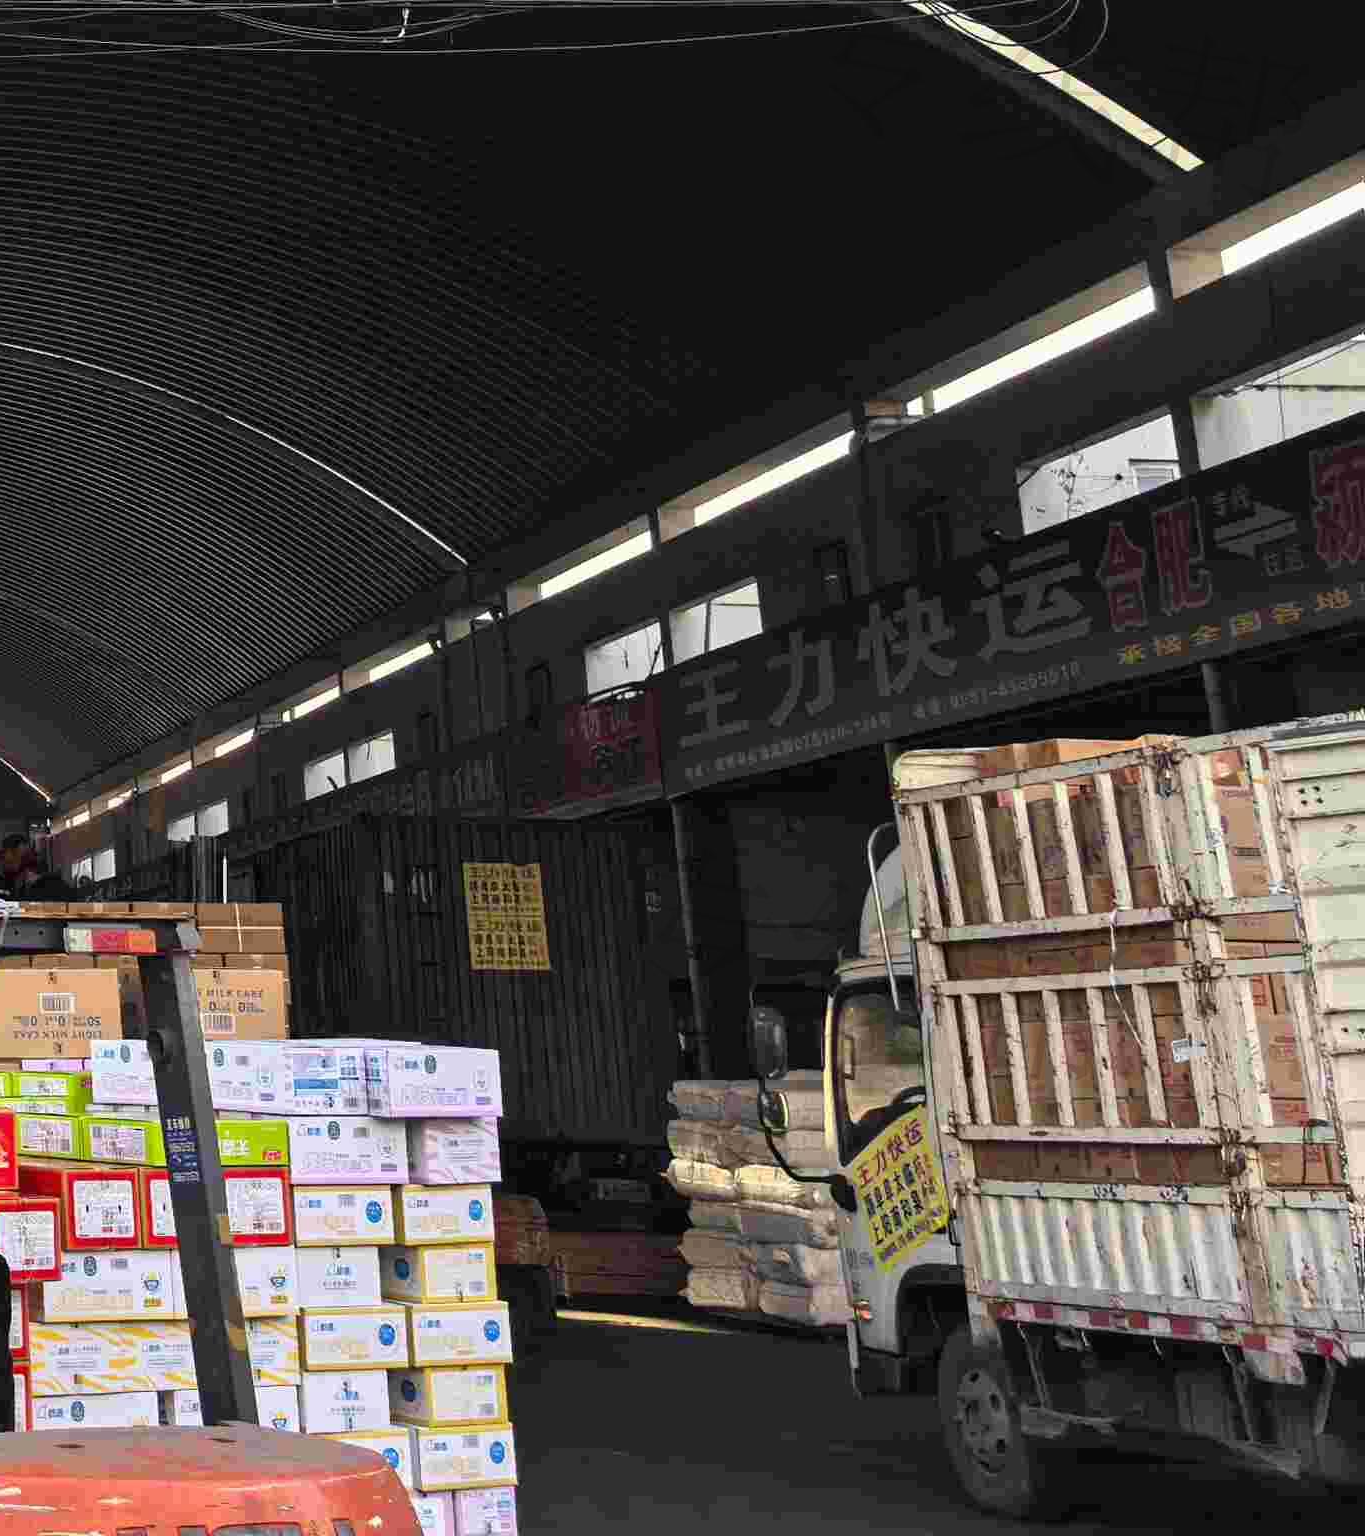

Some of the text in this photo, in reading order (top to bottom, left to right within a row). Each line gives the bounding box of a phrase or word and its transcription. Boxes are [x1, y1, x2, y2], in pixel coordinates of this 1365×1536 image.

[1095, 496, 1213, 632] 合肥
[1119, 580, 1365, 665] 承接全国各地
[679, 538, 1094, 749] 王力快运
